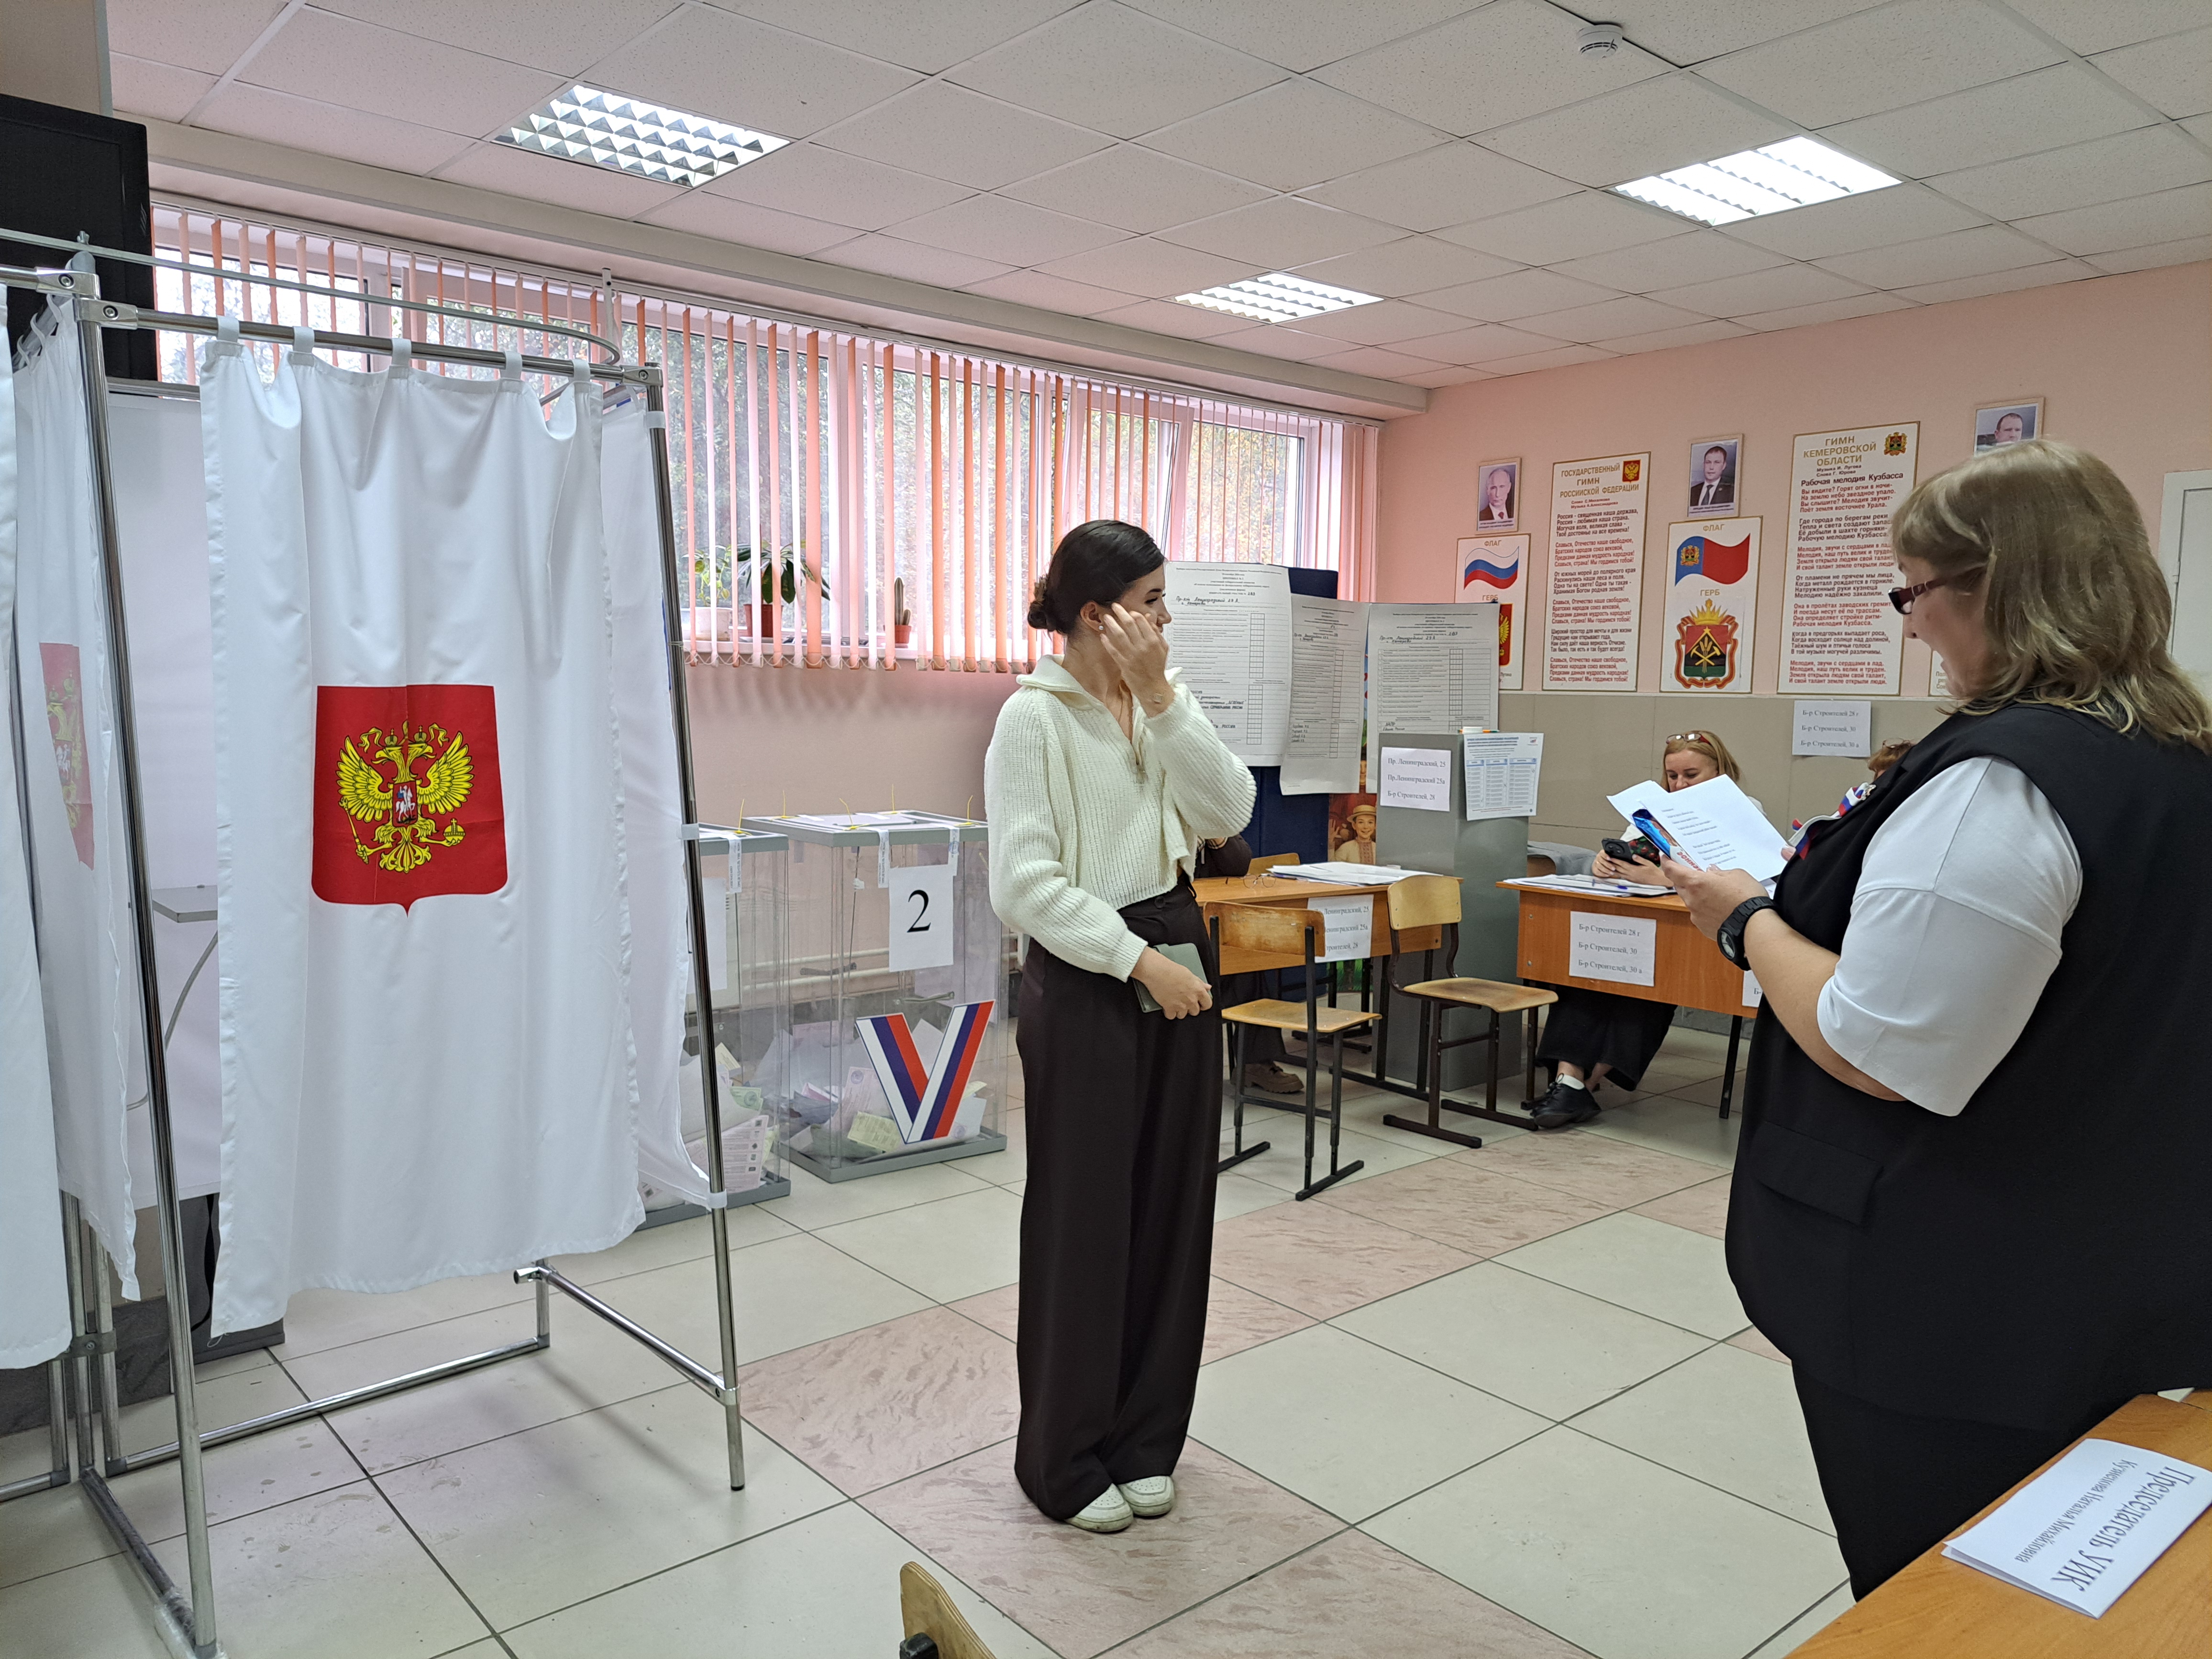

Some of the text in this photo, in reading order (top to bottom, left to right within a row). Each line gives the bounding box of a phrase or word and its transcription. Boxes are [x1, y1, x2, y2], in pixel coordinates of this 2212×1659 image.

[1825, 436, 1855, 446] ГИМН
[1803, 442, 1876, 458] КЕМЕРОВСКОЙ
[1817, 455, 1862, 466] ОБЛАСТИ
[1561, 463, 1620, 477] ГОСУДАРСТВЕННЫЙ
[1577, 477, 1600, 486] ГИМН
[1801, 471, 1903, 486] Рабочая мелодия Кузбасса
[1602, 484, 1639, 494] ФЕДЕРАЦИИ
[1398, 759, 1439, 767] Ленинградский,
[1397, 792, 1428, 800] Строителей,
[907, 889, 931, 933] 2
[1591, 925, 1627, 935] Строителей
[1327, 943, 1351, 951] троителей,
[1579, 941, 1588, 950] Б-р
[1590, 943, 1628, 954] Строителей,
[1579, 960, 1588, 968] Б-р
[1590, 961, 1628, 972] Строителей,
[2014, 1460, 2138, 1563] Кузнецова Наталья Михайловна
[2050, 1466, 2196, 1592] Председатель УИК
